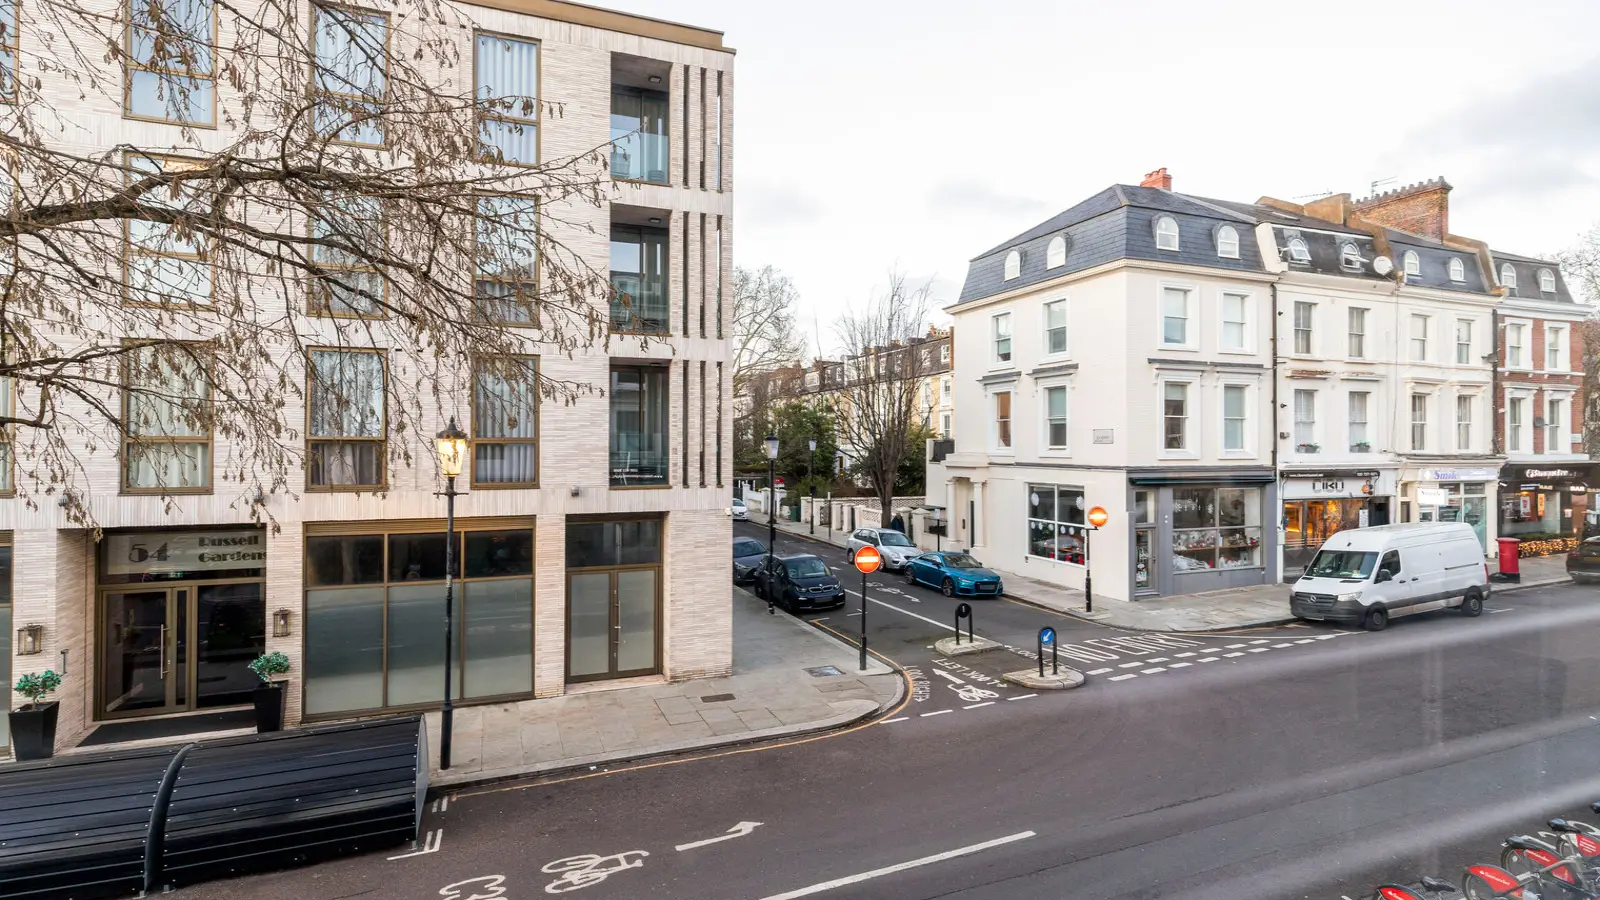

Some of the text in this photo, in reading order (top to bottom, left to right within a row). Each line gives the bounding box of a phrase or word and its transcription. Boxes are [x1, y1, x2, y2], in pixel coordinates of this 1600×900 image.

[128, 542, 171, 563] 54
[198, 535, 260, 547] Russell
[1042, 632, 1207, 664] NO ENTRY
[931, 658, 1001, 685] LOOK LEFT
